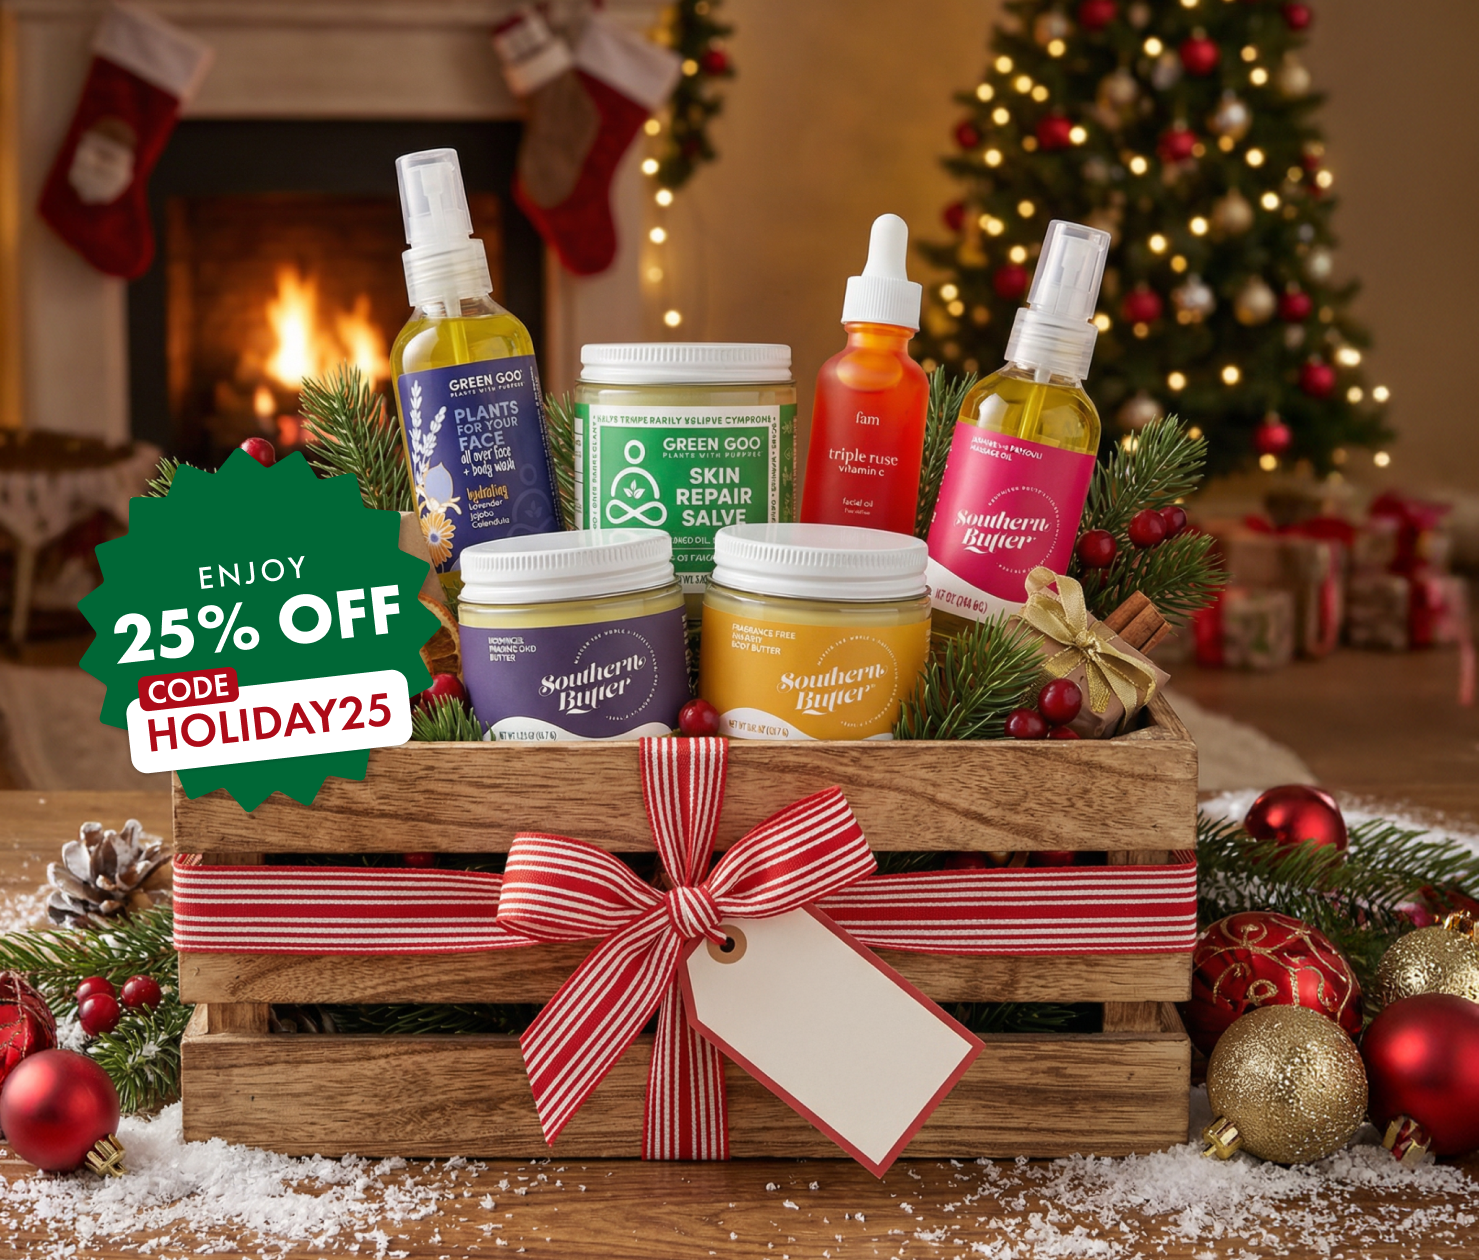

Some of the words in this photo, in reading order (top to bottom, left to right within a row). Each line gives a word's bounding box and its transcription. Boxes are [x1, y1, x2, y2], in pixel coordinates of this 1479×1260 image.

[449, 373, 493, 391] GREEN
[495, 370, 522, 383] GOO
[454, 400, 519, 424] PLANTS
[855, 411, 880, 426] fam
[457, 422, 482, 436] FOR
[484, 416, 518, 431] YOUR
[459, 431, 505, 451] FACE
[663, 437, 718, 451] GREEN
[724, 436, 761, 450] GOO
[461, 449, 472, 464] all
[473, 448, 492, 462] over
[494, 445, 511, 460] face
[829, 447, 866, 465] triple
[869, 454, 899, 466] ruse
[471, 460, 493, 478] body
[689, 467, 740, 484] SKIN
[838, 464, 876, 476] vitamin
[878, 469, 885, 477] c
[466, 483, 509, 504] hydrating
[676, 488, 752, 505] REPAIR
[842, 497, 862, 507] facial
[471, 517, 510, 529] Calendula
[682, 509, 746, 526] SALVE
[953, 508, 1052, 532] Southern
[961, 527, 1033, 555] Butter
[775, 630, 796, 640] FREE
[751, 644, 781, 655] BUTTER
[538, 654, 646, 697] Southern
[776, 663, 888, 694] Southern
[558, 681, 632, 715] Butter
[795, 684, 871, 716] Butter
